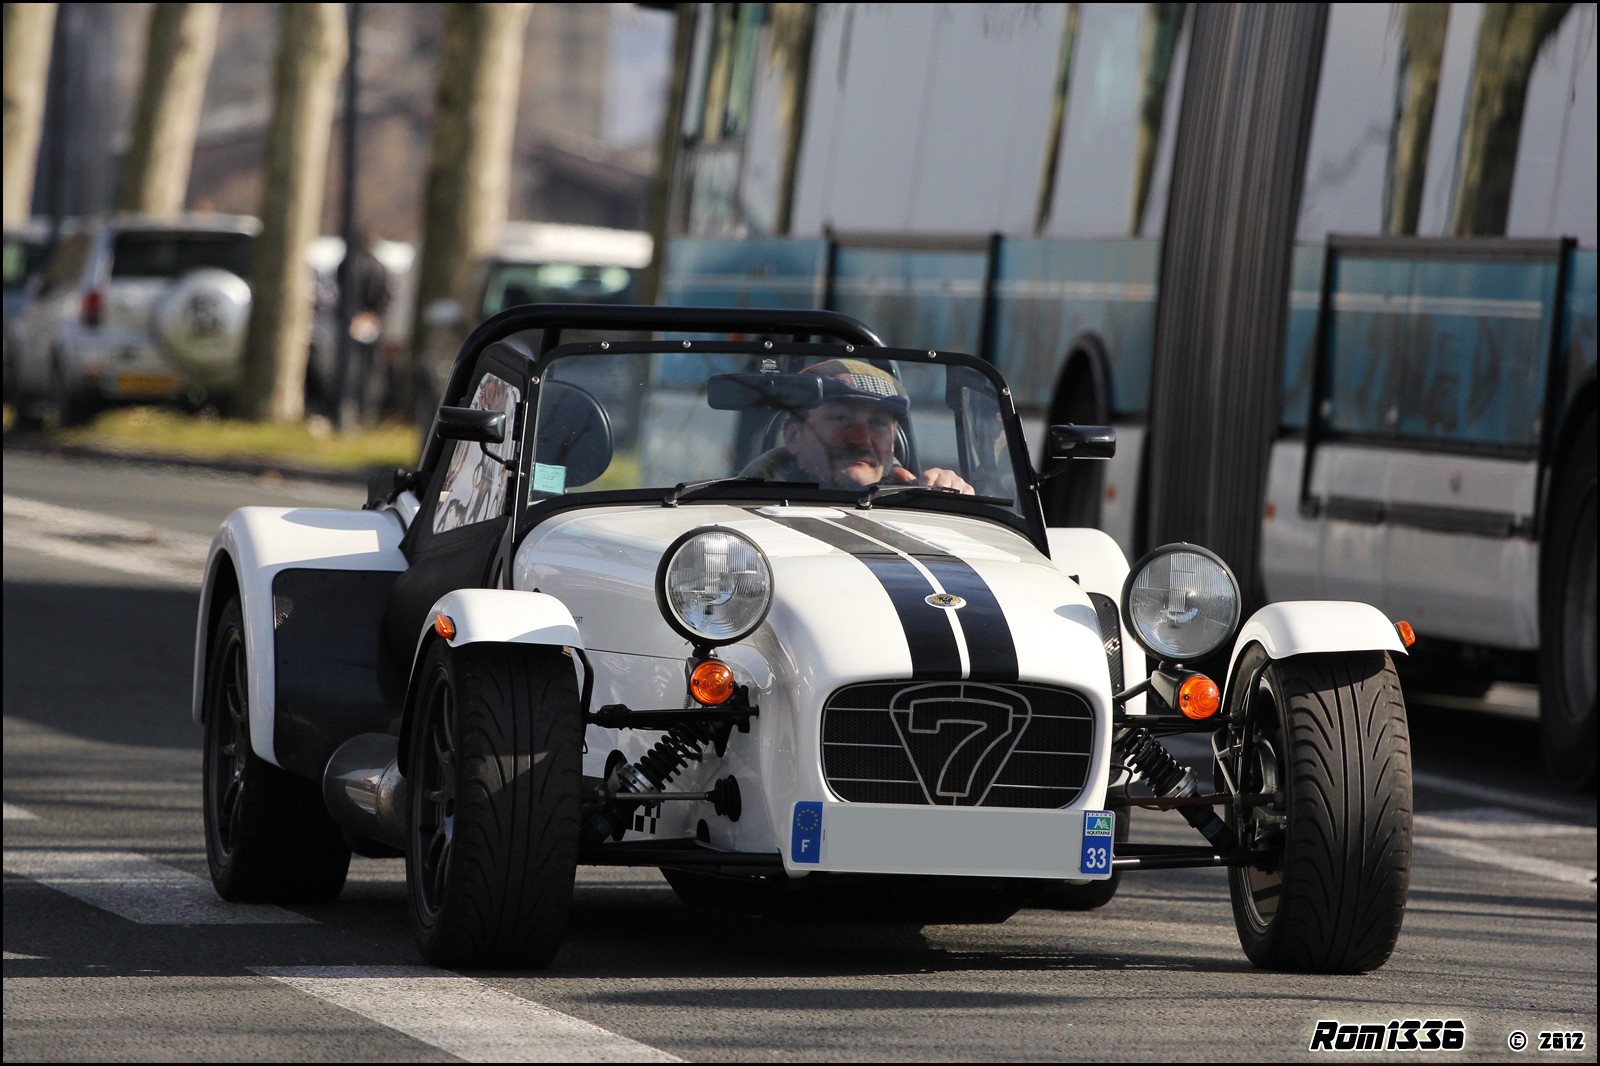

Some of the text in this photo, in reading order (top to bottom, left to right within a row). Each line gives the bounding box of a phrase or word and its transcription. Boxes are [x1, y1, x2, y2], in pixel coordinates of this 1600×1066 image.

[909, 697, 1013, 797] 7
[801, 839, 810, 852] F
[1086, 847, 1107, 869] 33
